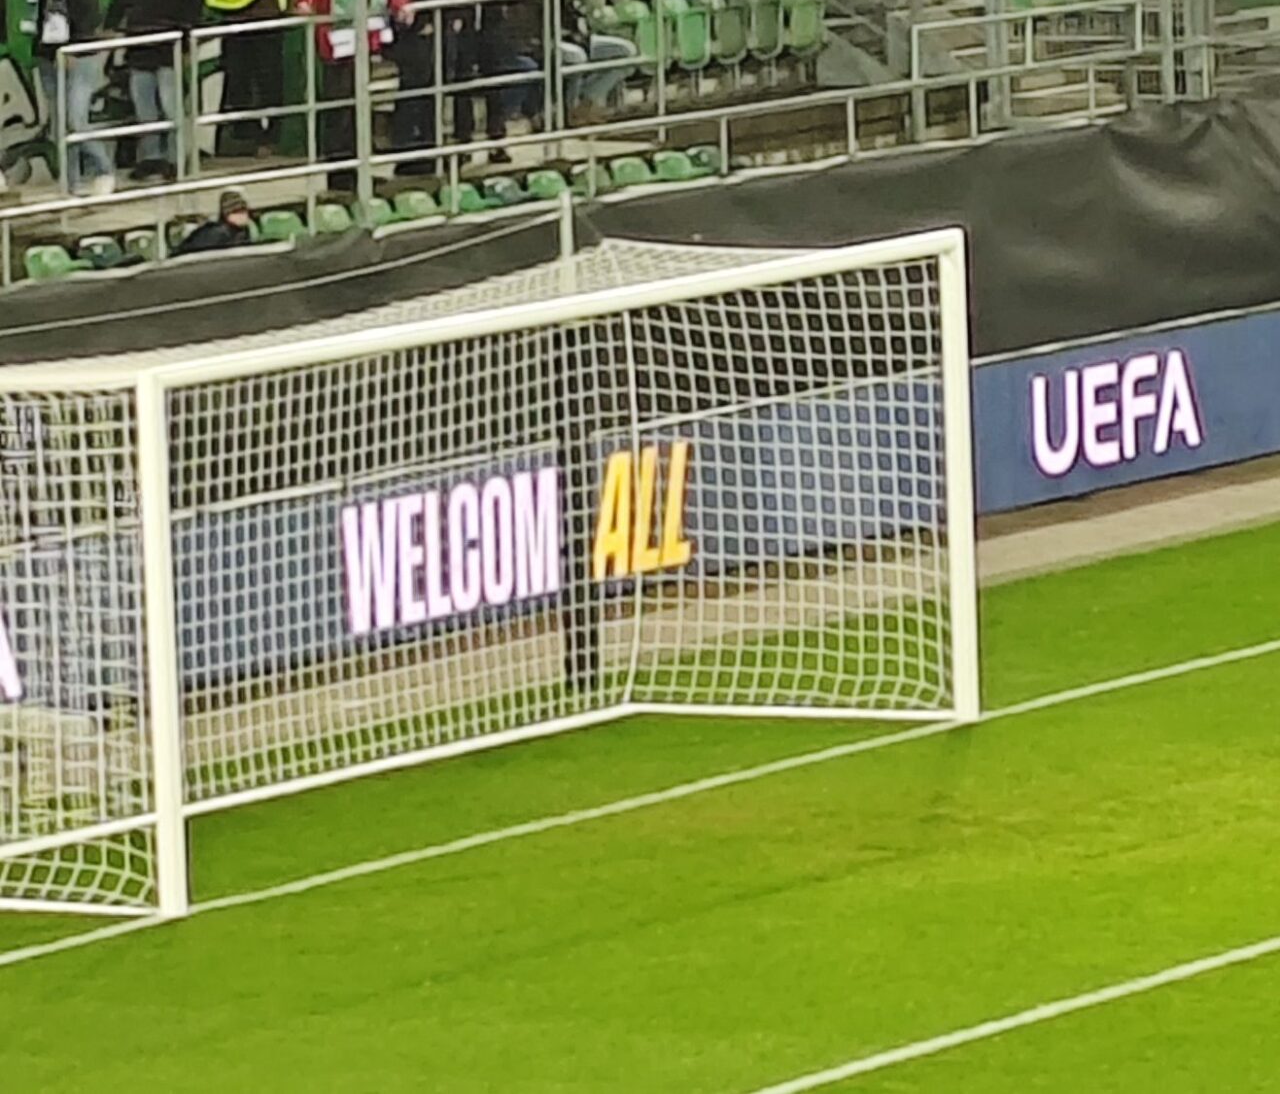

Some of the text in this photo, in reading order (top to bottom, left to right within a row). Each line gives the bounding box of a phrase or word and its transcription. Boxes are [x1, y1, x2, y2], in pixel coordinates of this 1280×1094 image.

[1032, 349, 1201, 474] UEFA
[342, 441, 691, 635] WELCOM ALL
